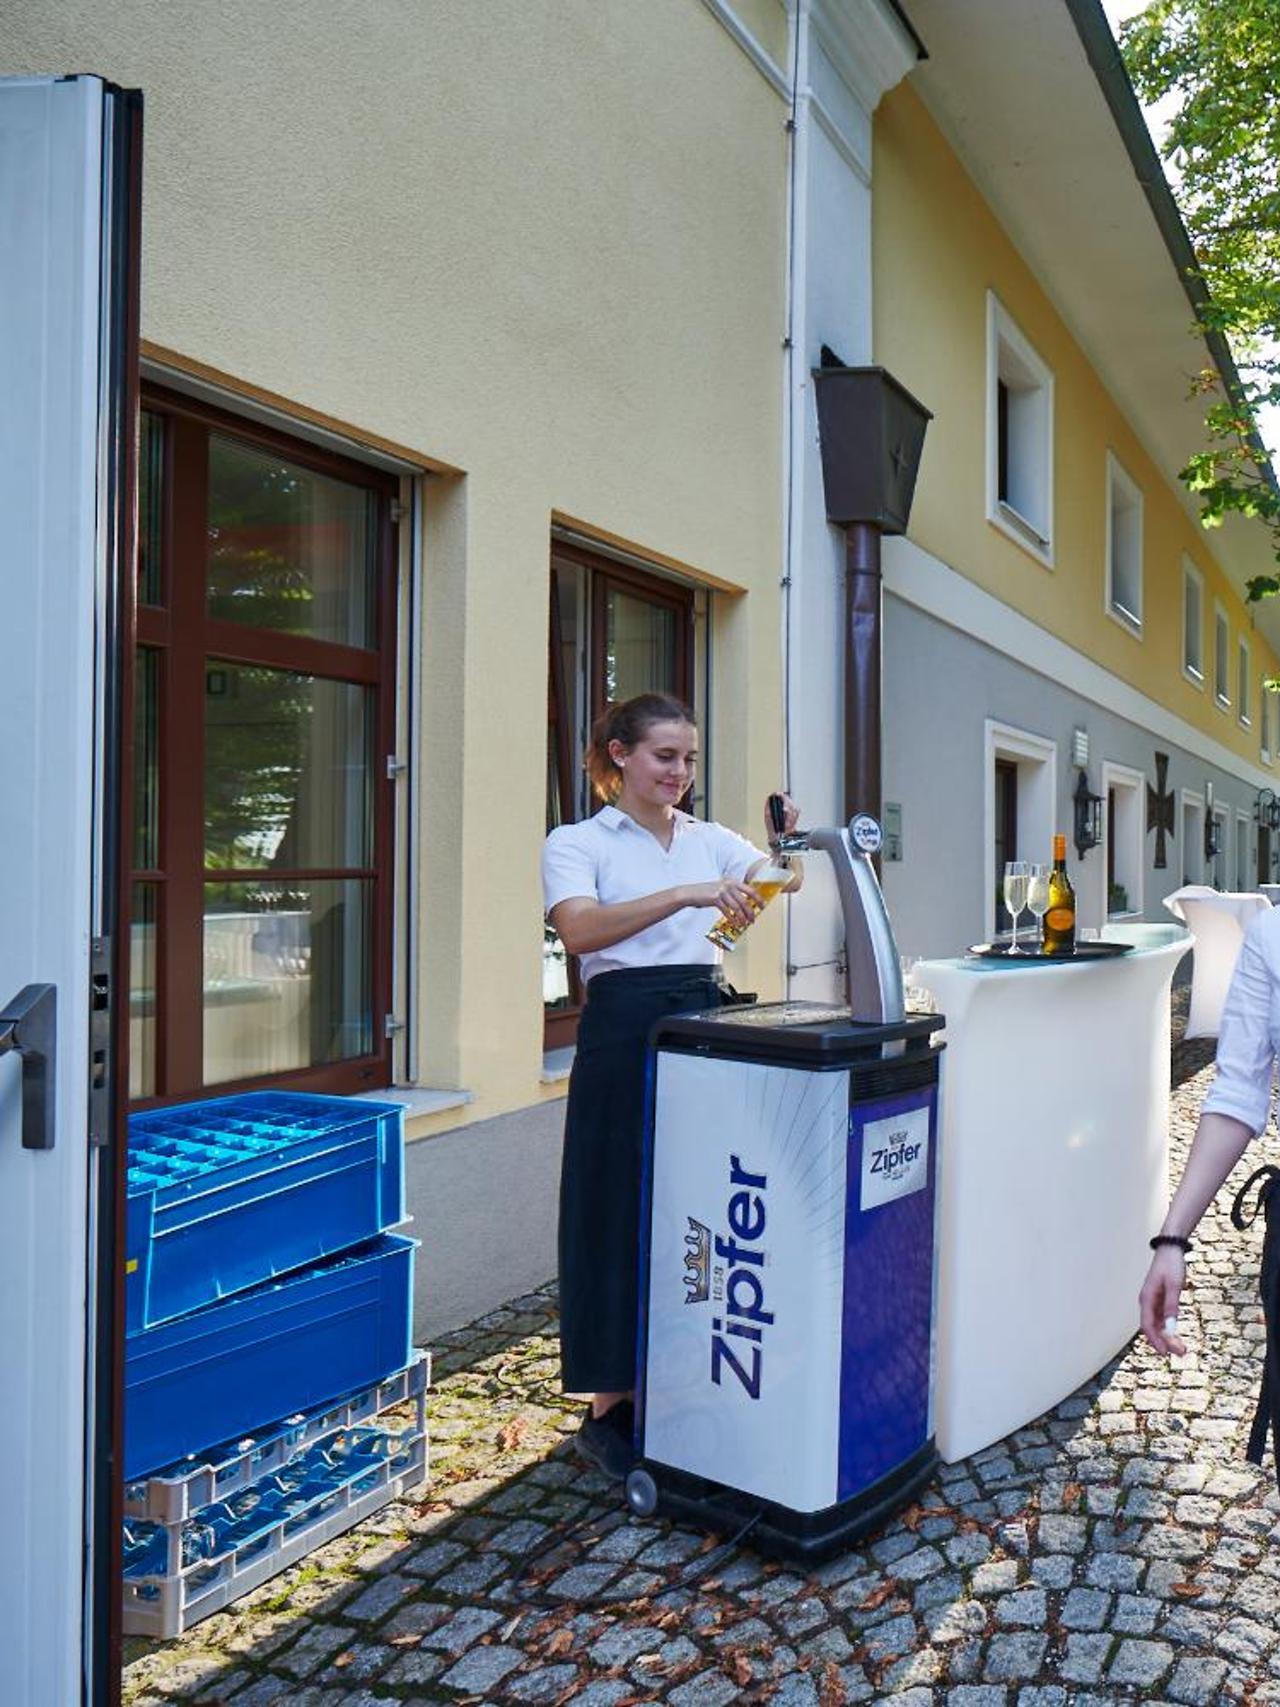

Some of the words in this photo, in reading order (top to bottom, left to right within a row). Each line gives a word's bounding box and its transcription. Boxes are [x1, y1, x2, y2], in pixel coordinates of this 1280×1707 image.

[870, 1143, 922, 1173] Zipfer
[711, 1154, 775, 1400] Zipfer
[712, 1265, 725, 1302] 1858
